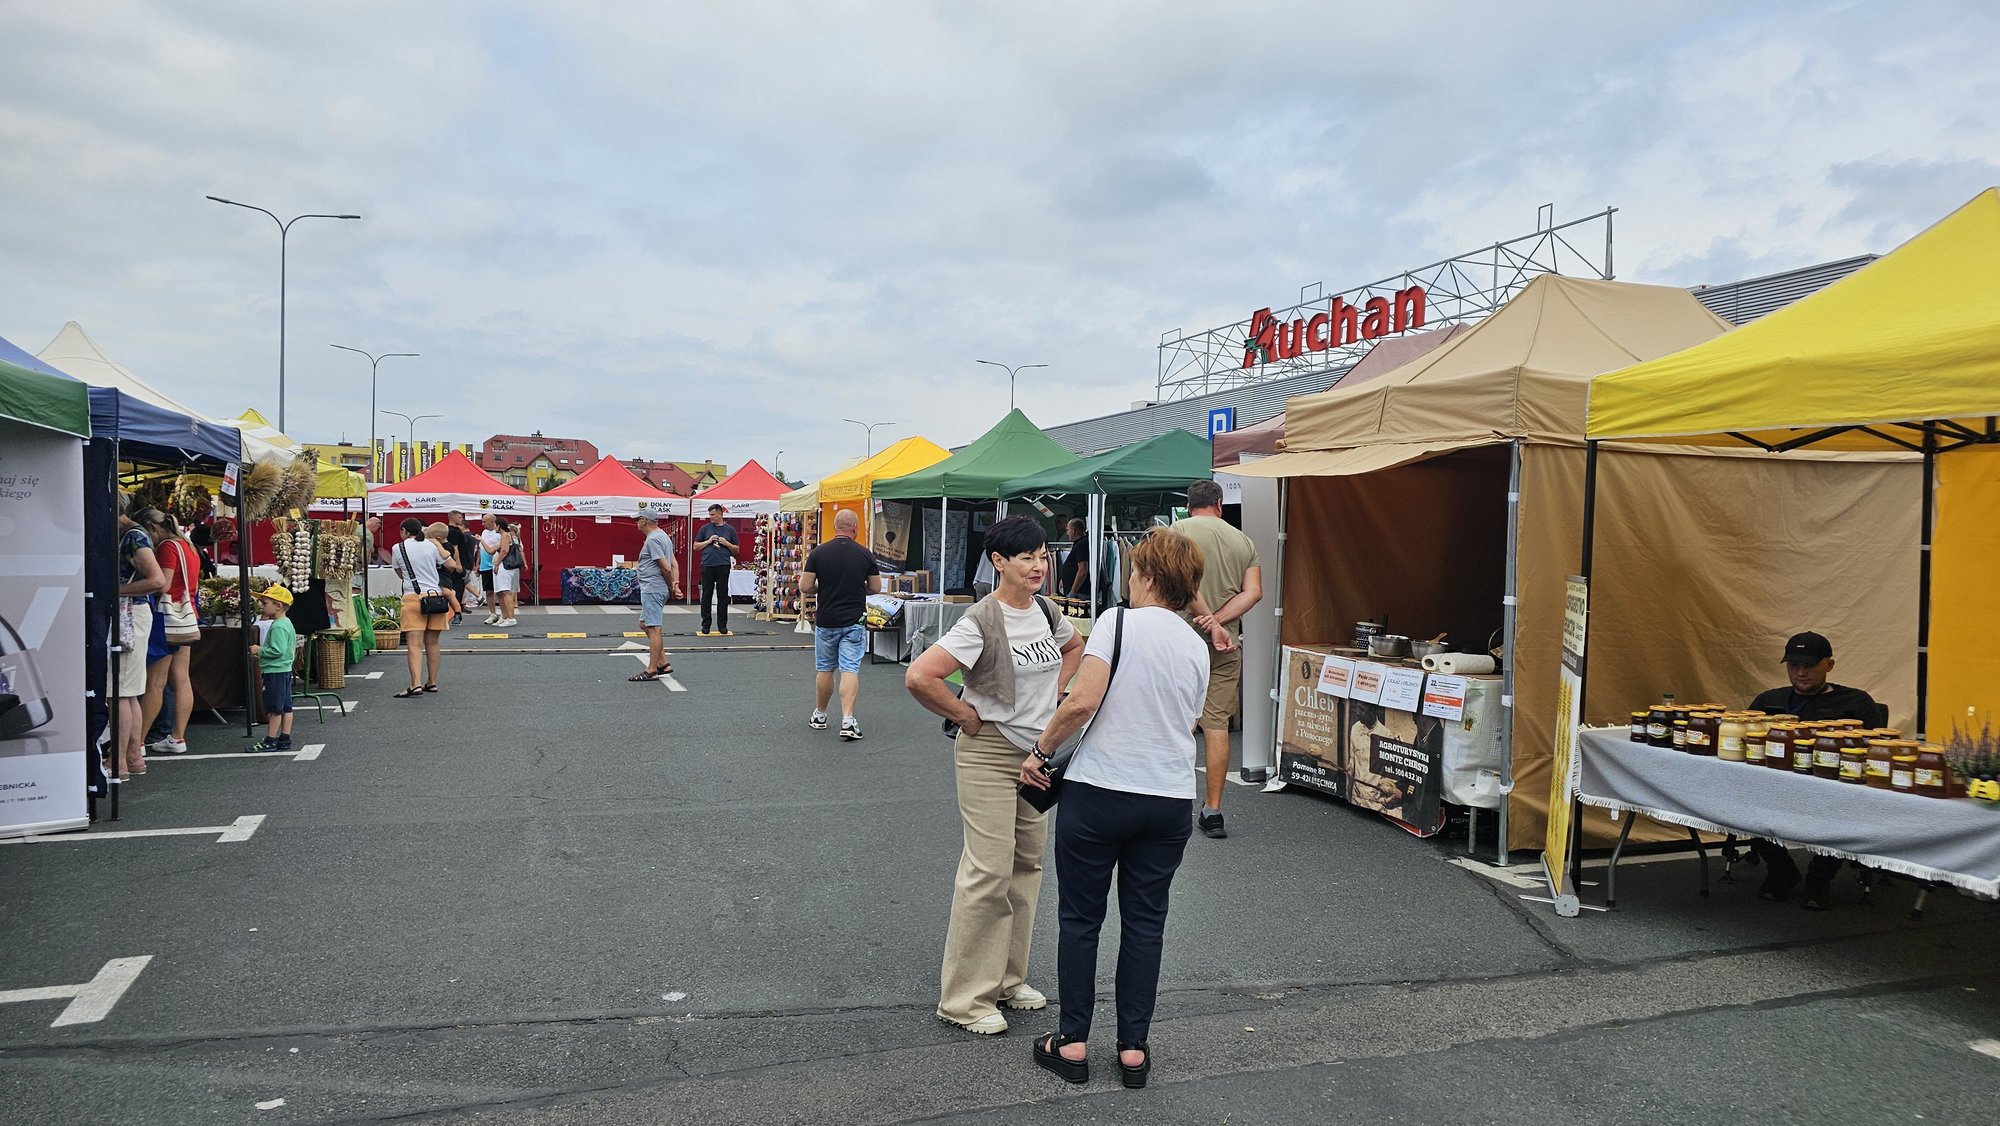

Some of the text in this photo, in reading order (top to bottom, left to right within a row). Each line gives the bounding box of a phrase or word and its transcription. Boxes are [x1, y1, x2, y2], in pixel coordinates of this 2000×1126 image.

[1242, 285, 1426, 368] Auchan
[20, 475, 40, 488] się
[1294, 685, 1334, 713] Chleb
[1379, 750, 1403, 765] MONTE
[1317, 765, 1326, 776] 80
[1384, 765, 1395, 774] tel.
[1404, 771, 1415, 781] 432
